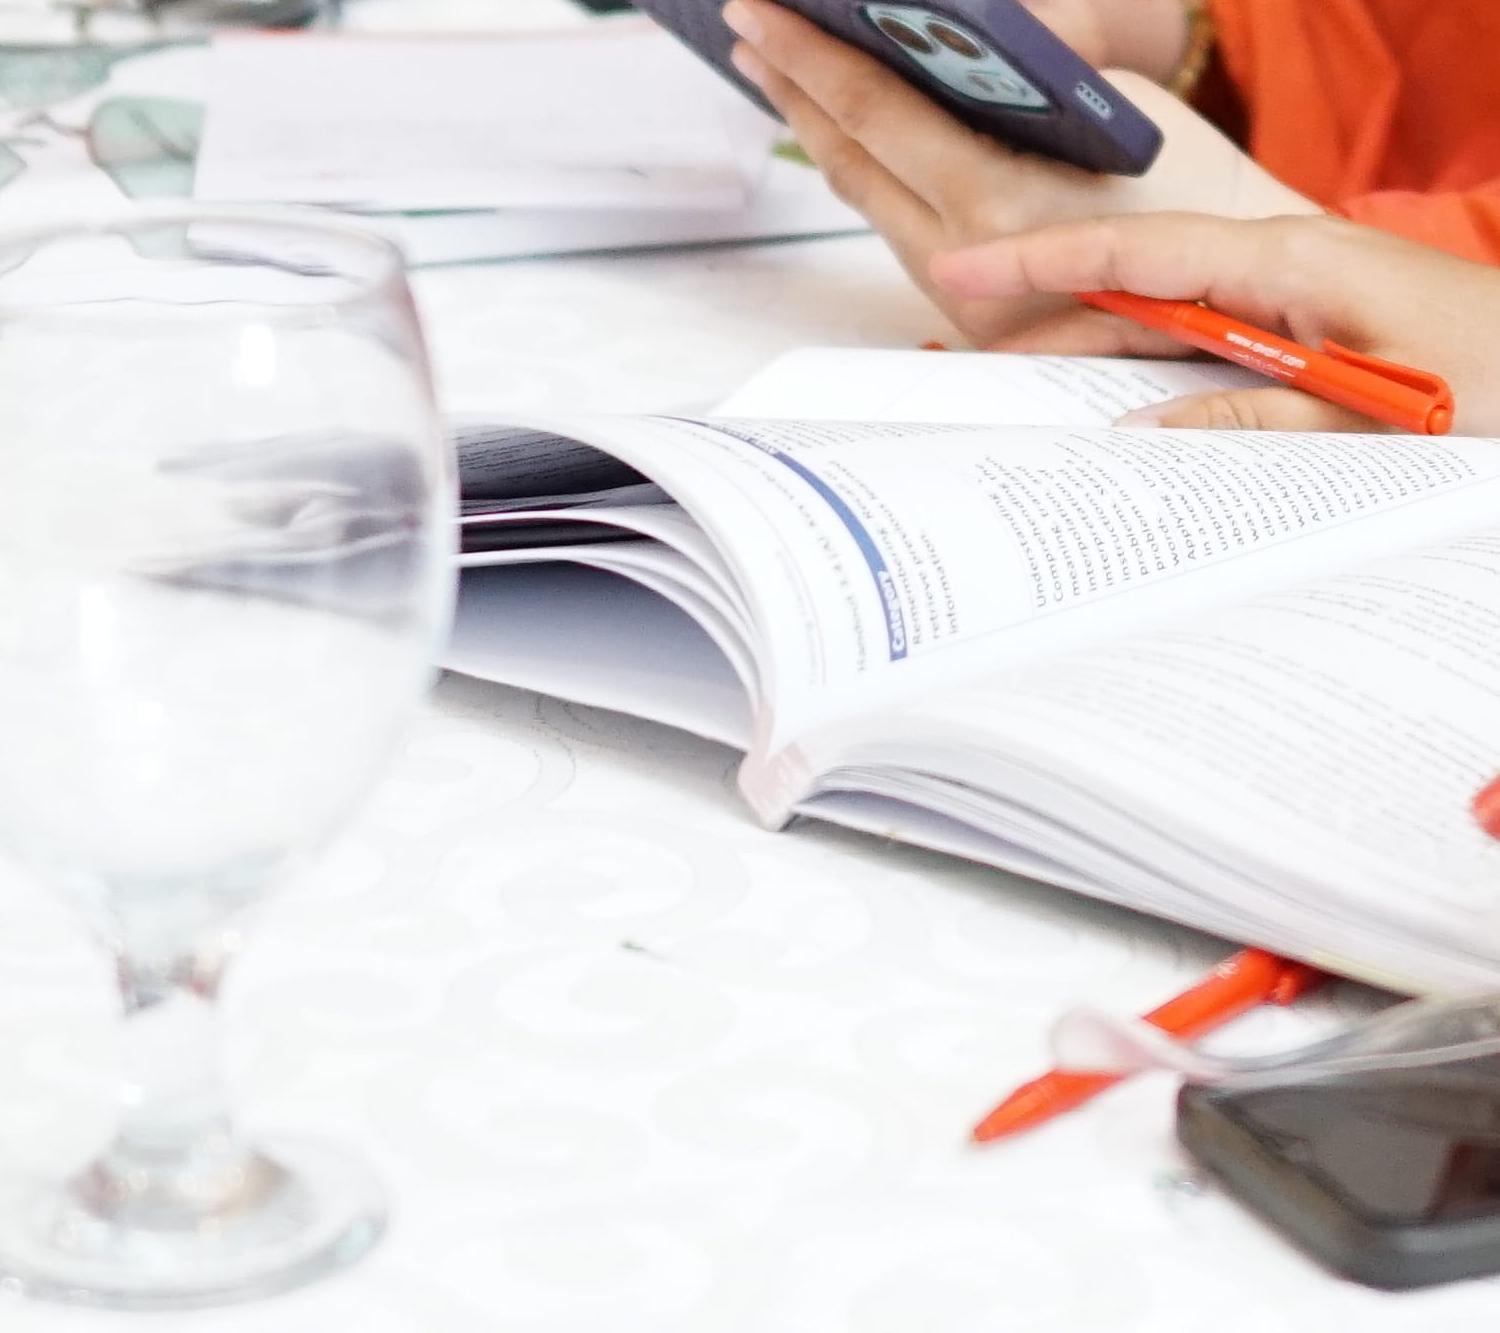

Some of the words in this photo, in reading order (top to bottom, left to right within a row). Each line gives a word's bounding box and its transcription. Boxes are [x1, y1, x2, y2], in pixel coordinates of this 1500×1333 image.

[1130, 504, 1168, 572] problem
[1244, 510, 1260, 542] was
[1202, 540, 1213, 558] in
